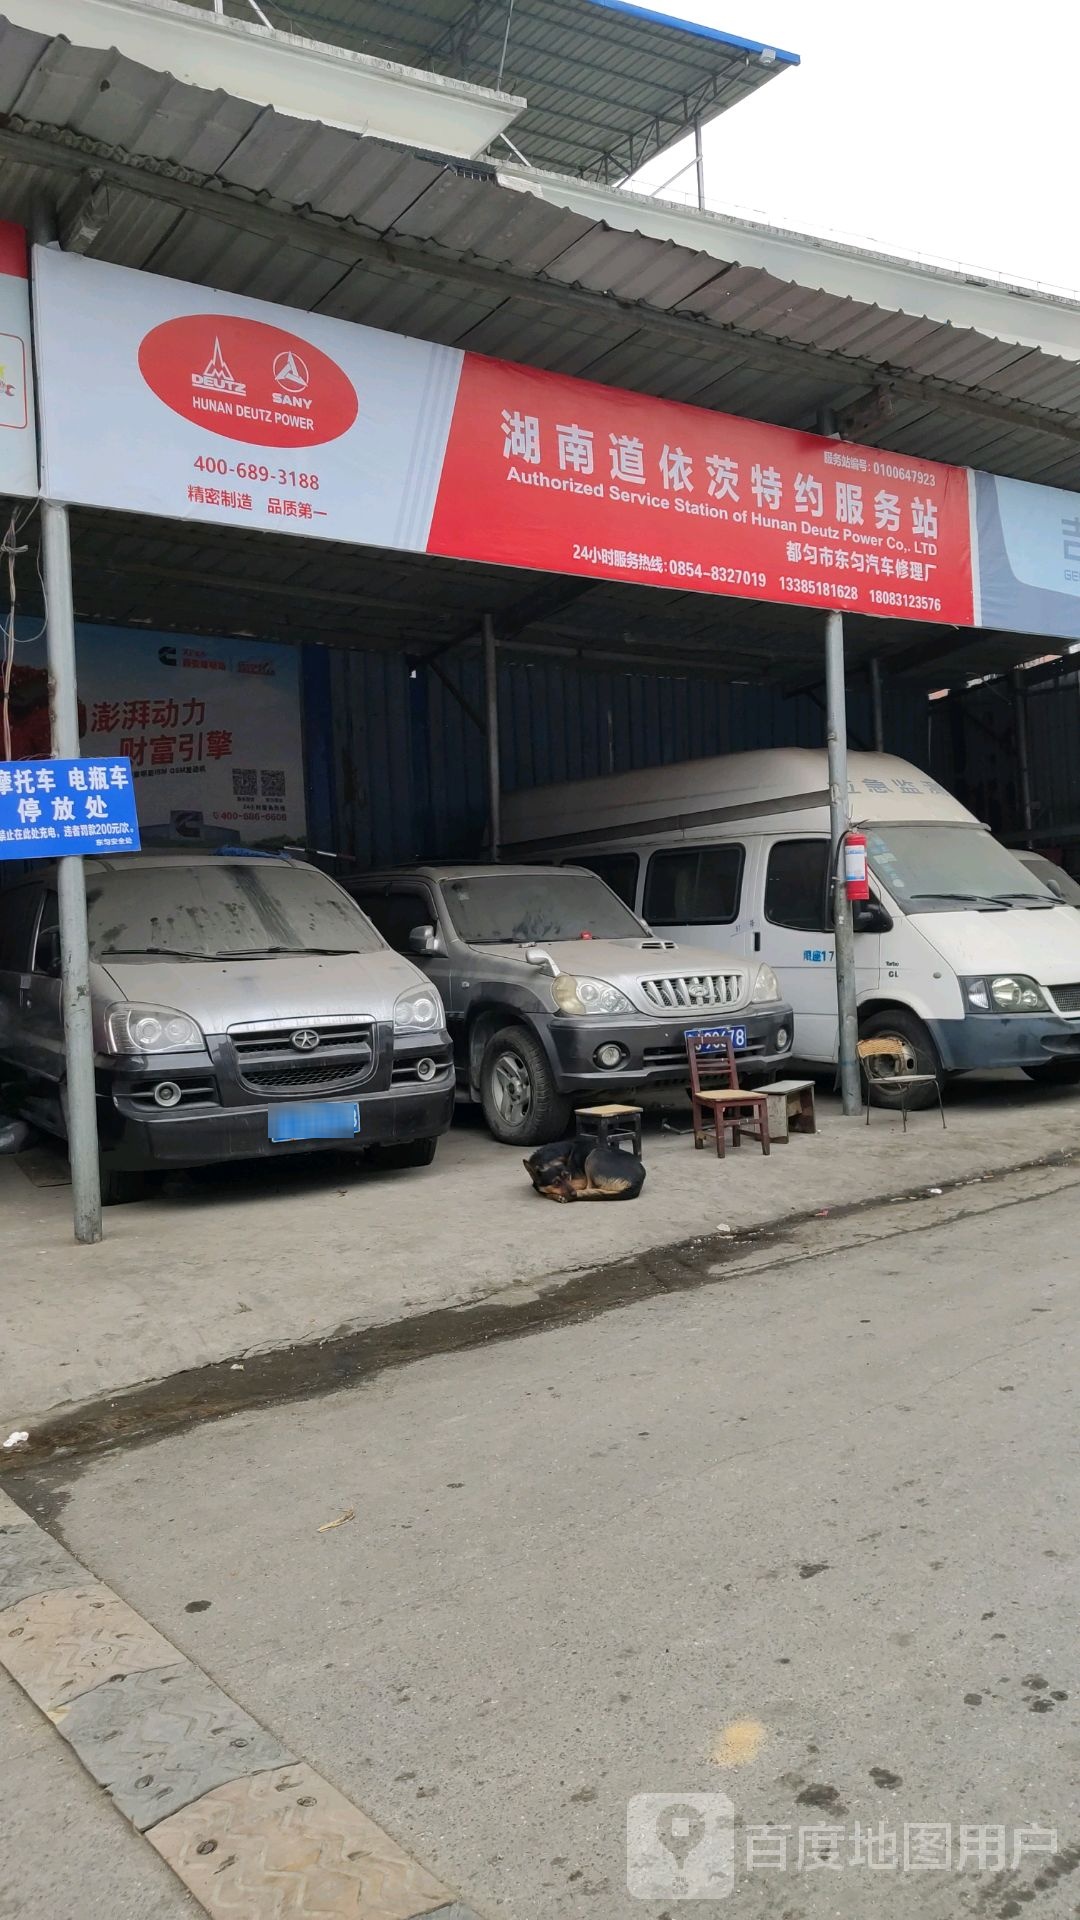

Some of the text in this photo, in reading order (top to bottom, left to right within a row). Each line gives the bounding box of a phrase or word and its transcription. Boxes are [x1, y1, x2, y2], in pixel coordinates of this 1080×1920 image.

[191, 373, 247, 393] DEUTZ
[192, 396, 315, 431] HUNAN DEUTZ POWER
[271, 393, 313, 409] SANY
[193, 455, 320, 491] 400-689-3188
[501, 408, 938, 539] 湖南道依茨特约服务站
[187, 484, 328, 519] 精密制造 品质第一
[506, 466, 604, 497] Authorized
[609, 485, 670, 509] Service
[674, 497, 729, 520] Station
[733, 512, 747, 524] of
[751, 512, 797, 532] Hunan
[801, 521, 840, 540] Deutz
[843, 528, 883, 547] Power
[914, 541, 938, 556] LTD
[786, 540, 938, 582] 都匀市东匀汽车修理厂
[1064, 569, 1080, 582] GE
[779, 576, 858, 600] 13385181628
[869, 589, 941, 612] 18083123576
[91, 697, 206, 733] 澎湃动力
[119, 729, 233, 767] 财富引擎
[0, 765, 129, 795] 摩托车 电瓶车
[17, 795, 109, 824] 停放处
